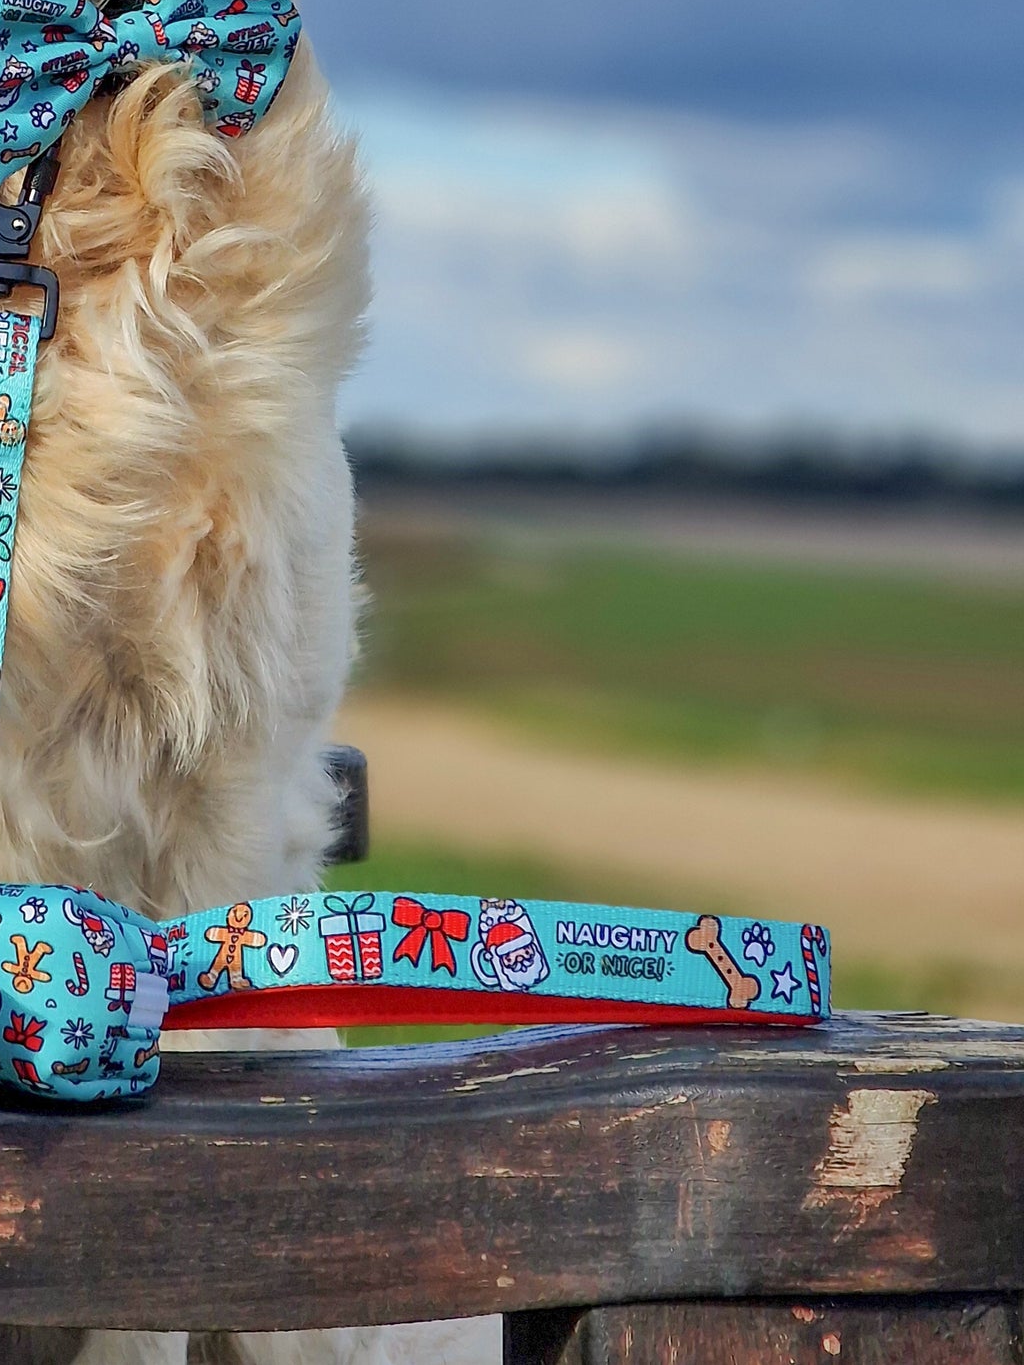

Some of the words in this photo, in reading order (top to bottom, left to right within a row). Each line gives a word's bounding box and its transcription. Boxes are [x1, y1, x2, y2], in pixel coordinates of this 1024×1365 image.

[232, 34, 272, 54] GIFT
[556, 920, 679, 954] NAUGHTY
[564, 952, 596, 975] OR
[600, 954, 666, 983] NICE!
